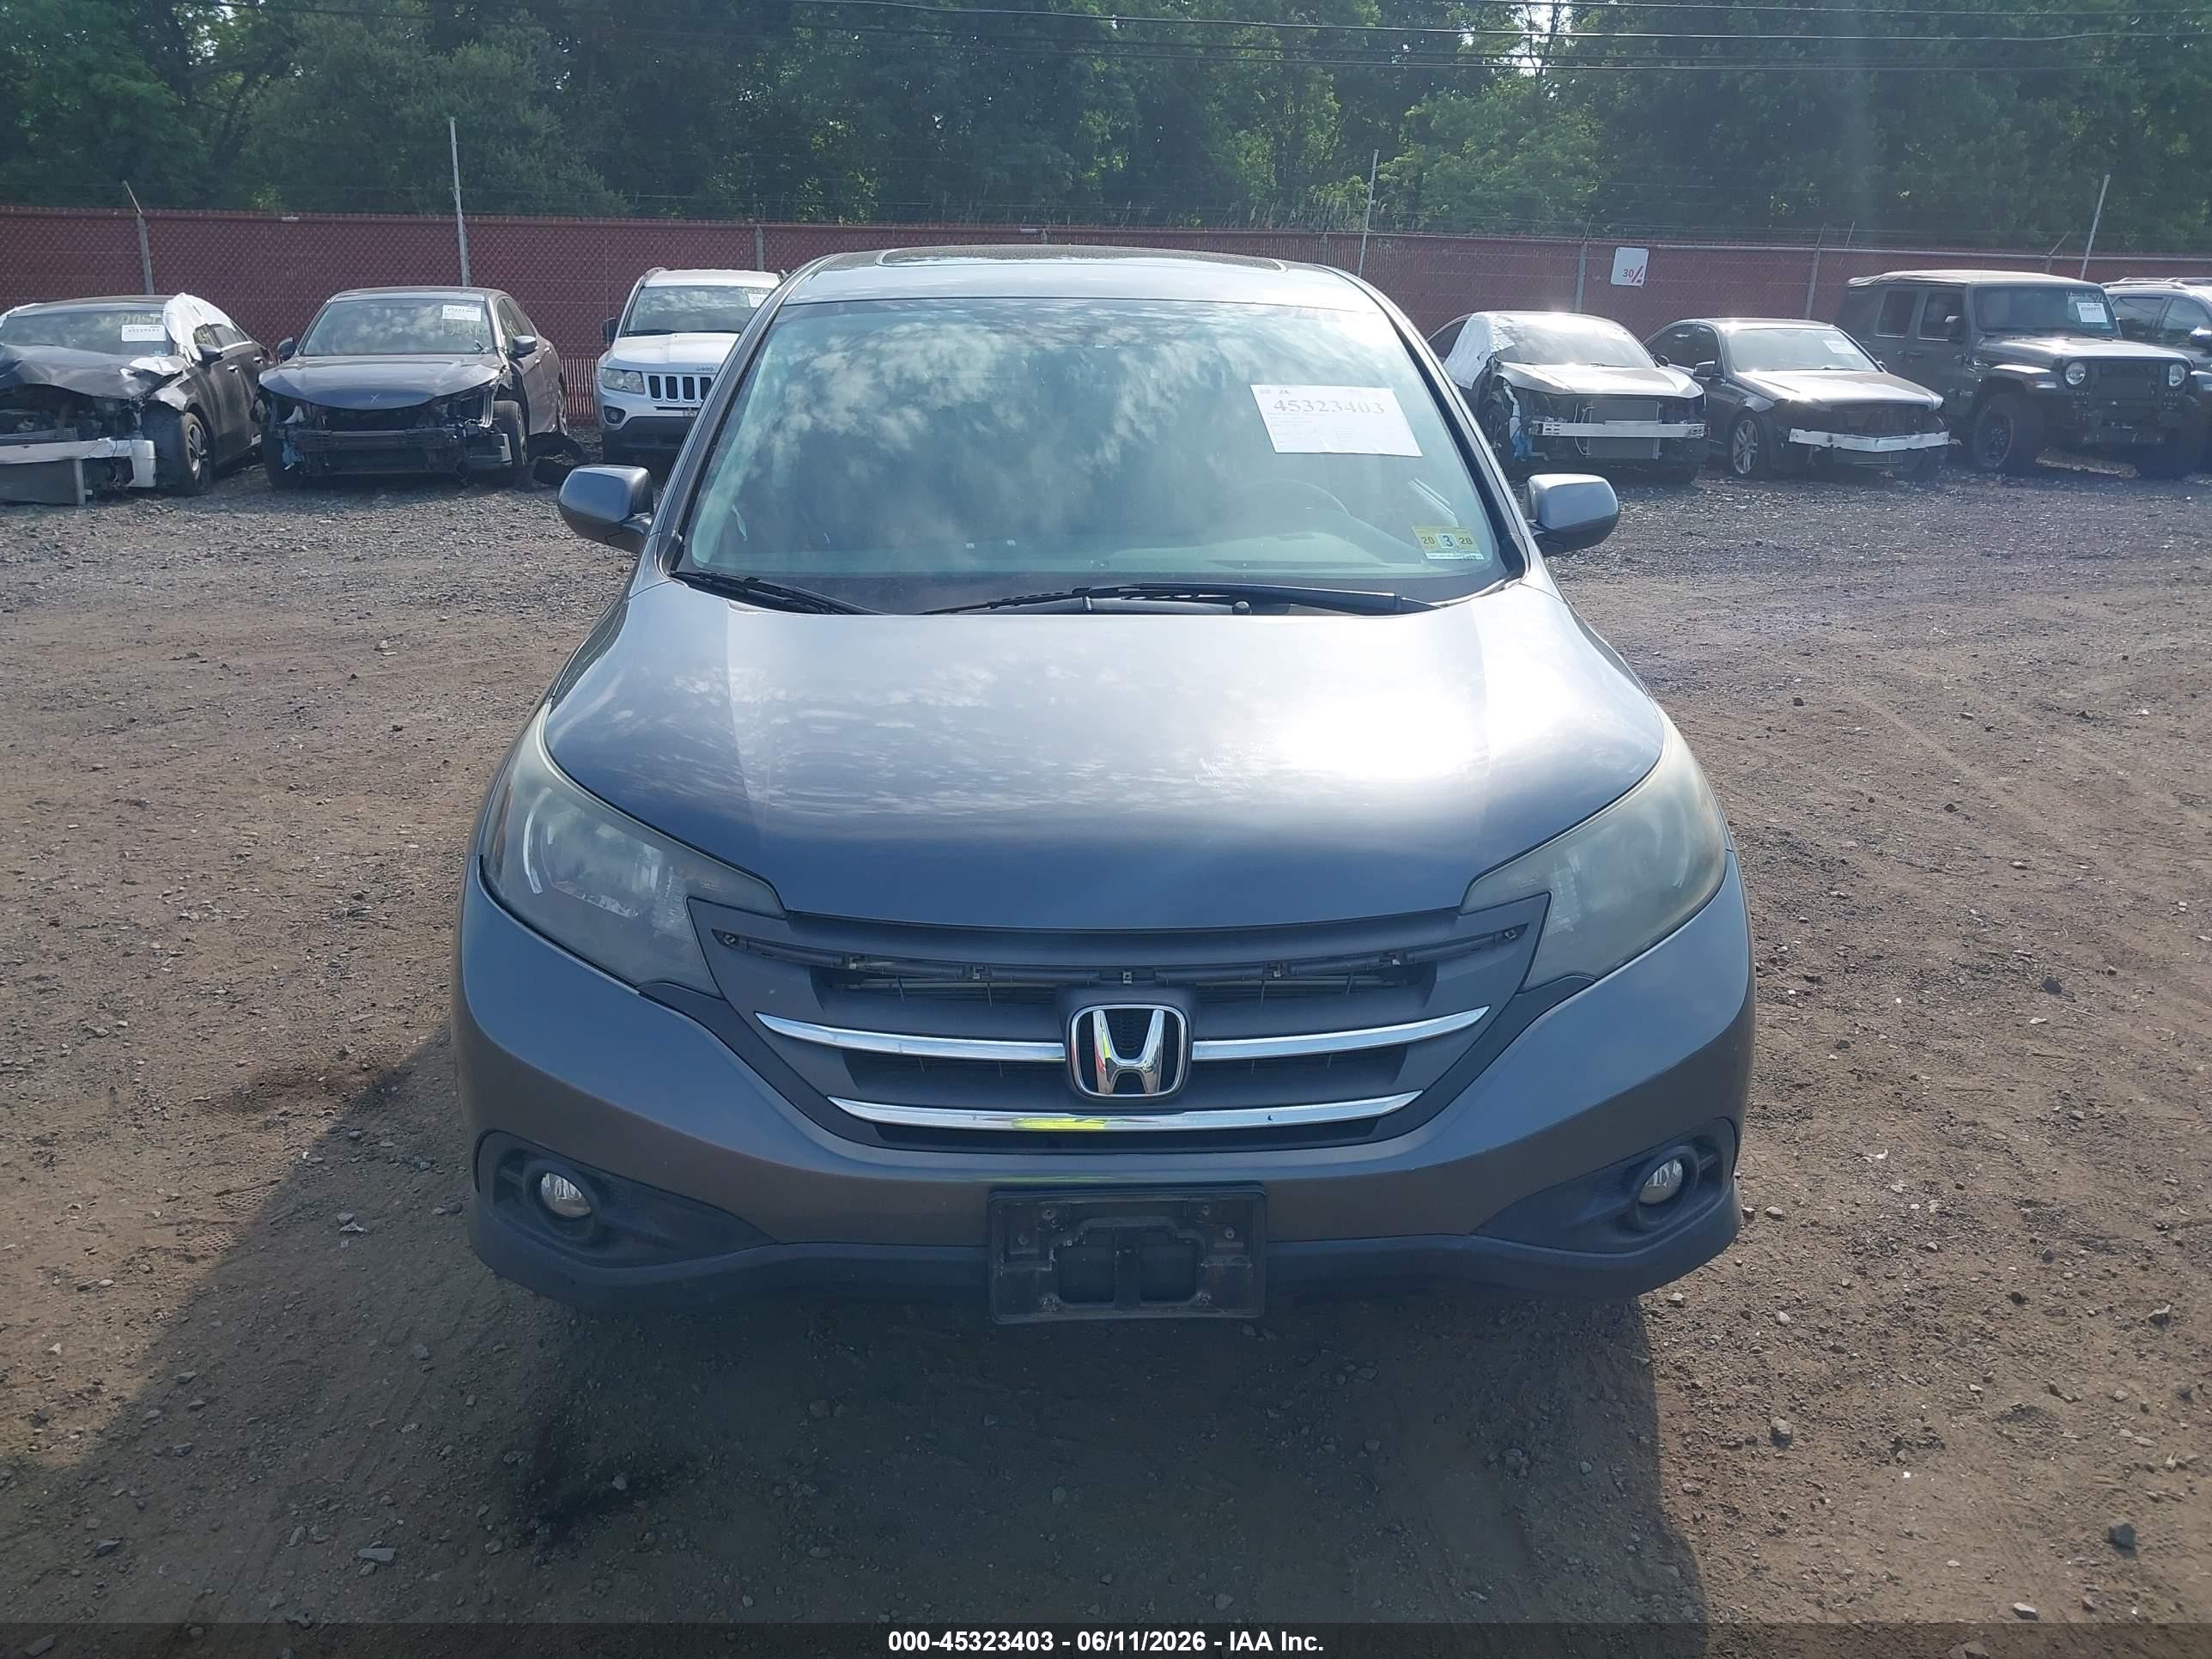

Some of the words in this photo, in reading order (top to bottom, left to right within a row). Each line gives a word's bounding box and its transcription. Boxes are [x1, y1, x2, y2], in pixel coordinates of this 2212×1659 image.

[1622, 268, 1634, 278] 30
[1273, 398, 1385, 414] 45323403
[1421, 535, 1436, 545] 20
[1443, 535, 1454, 547] 3
